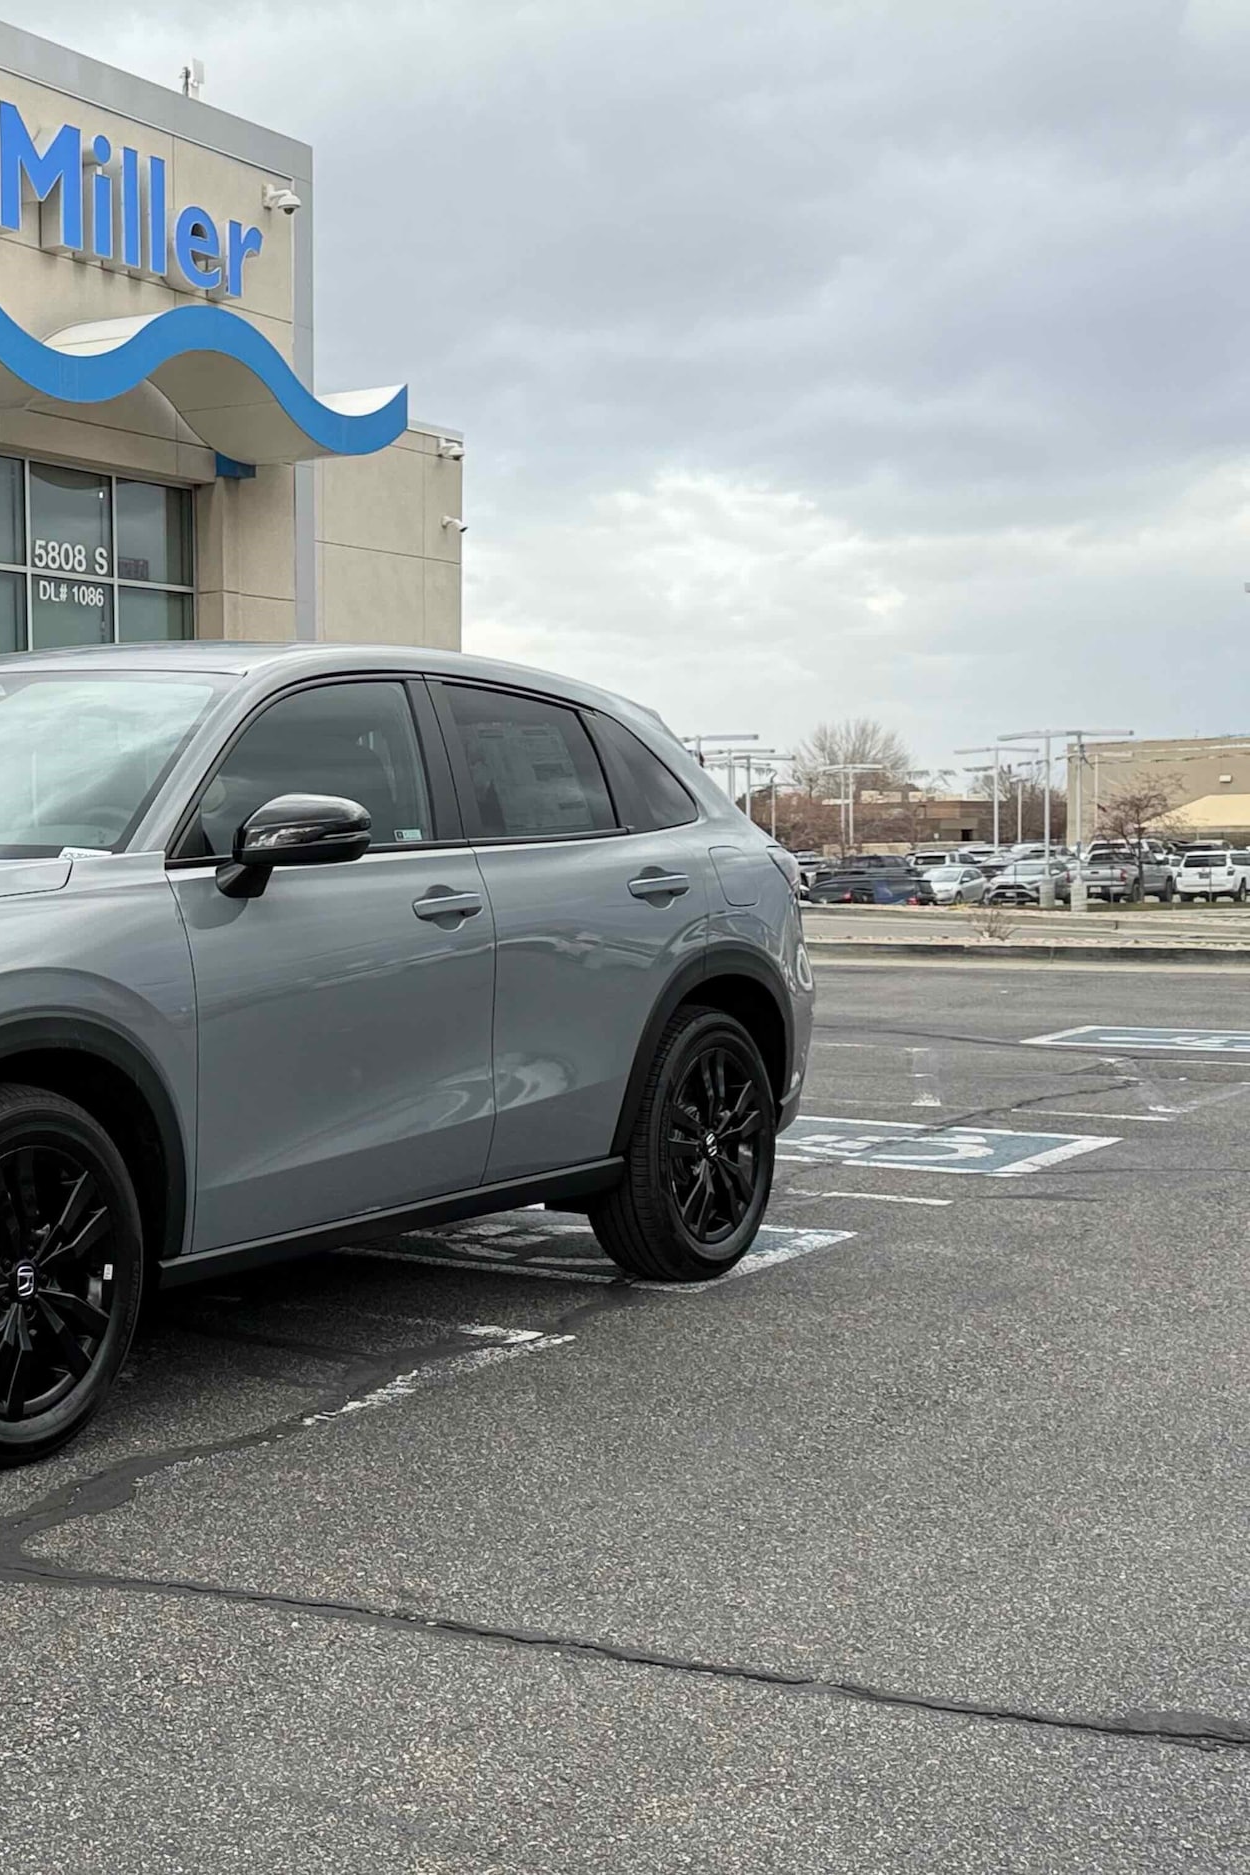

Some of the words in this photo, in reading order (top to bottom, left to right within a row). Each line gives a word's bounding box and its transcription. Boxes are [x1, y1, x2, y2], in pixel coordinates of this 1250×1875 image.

[34, 539, 87, 572] 5808
[94, 546, 108, 575] S
[39, 580, 67, 602] DL#
[72, 585, 104, 607] 1086
